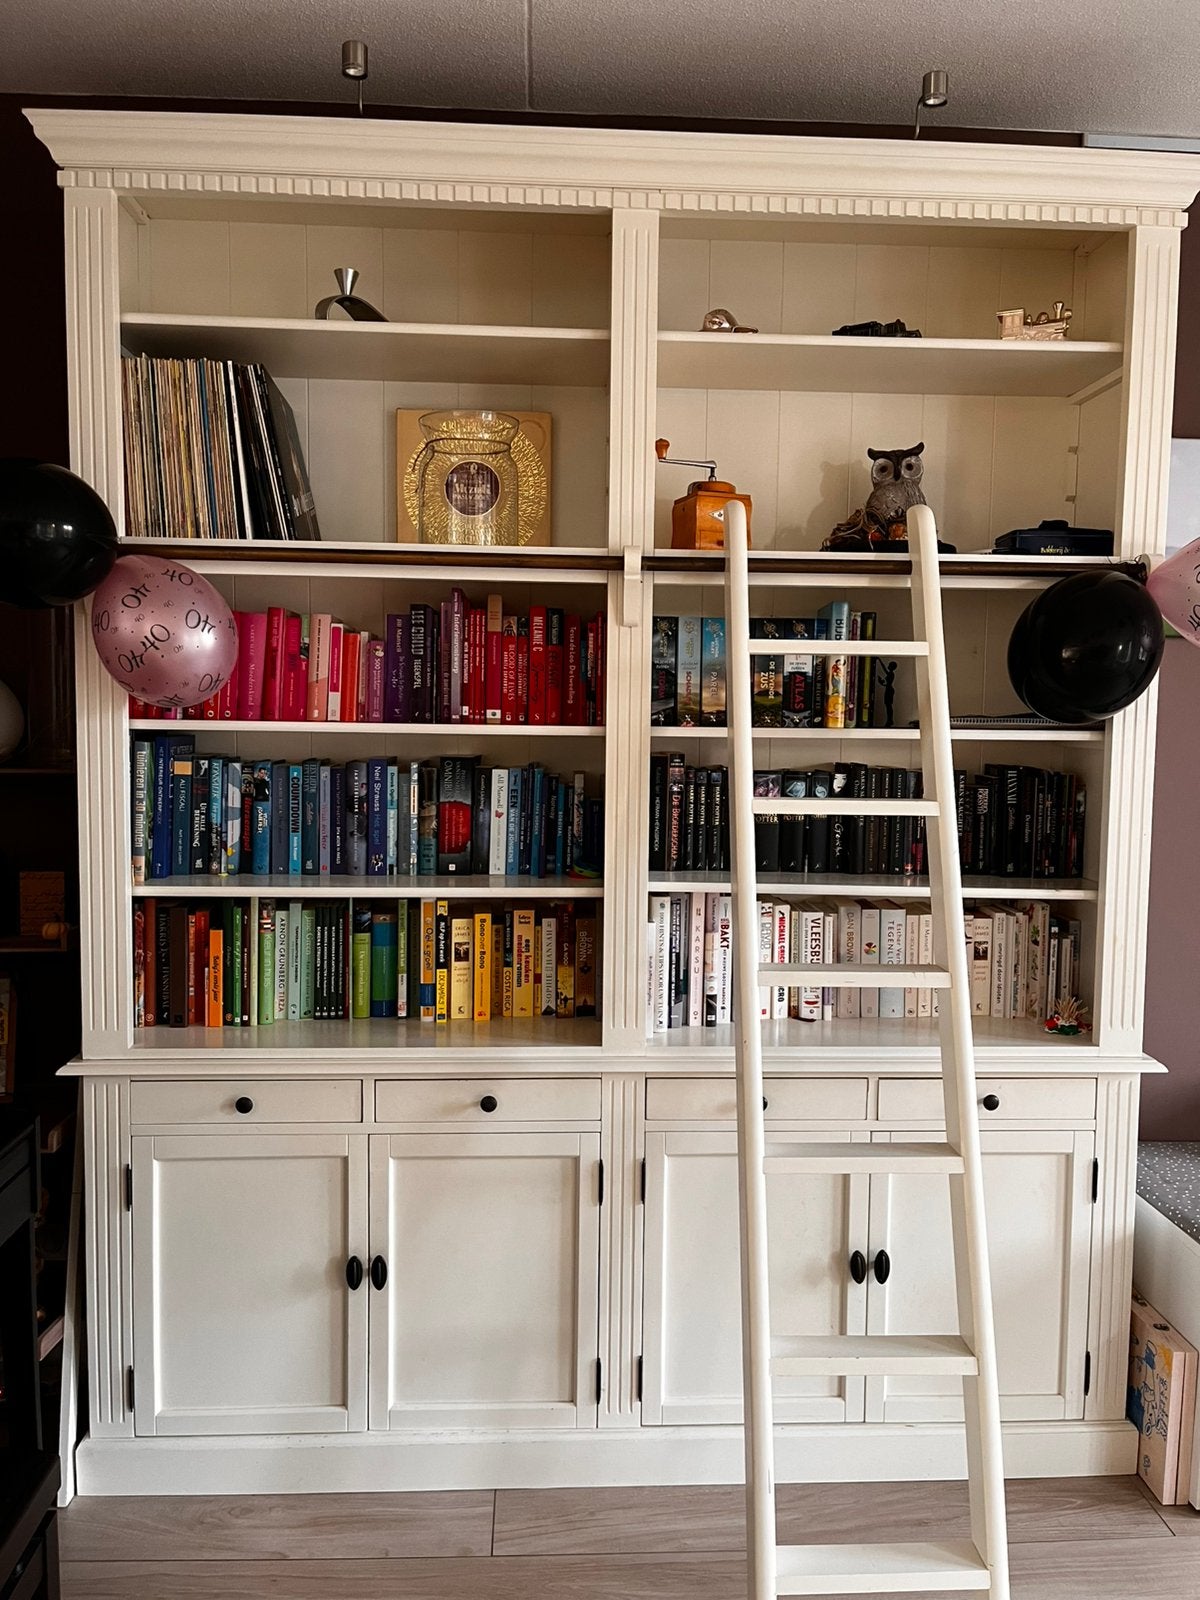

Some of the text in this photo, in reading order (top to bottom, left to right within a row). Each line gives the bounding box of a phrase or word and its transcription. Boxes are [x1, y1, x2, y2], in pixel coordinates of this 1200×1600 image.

[161, 568, 193, 586] 40
[122, 584, 151, 608] 40
[94, 610, 110, 632] 40
[186, 609, 216, 634] 40
[533, 616, 543, 645] MELANIE
[140, 624, 170, 652] 40
[411, 610, 424, 689] LEE CHILD TEGENSPEL
[452, 613, 460, 674] Interieurontwerp
[118, 650, 146, 673] 40
[569, 666, 575, 674] De
[769, 661, 775, 670] DE
[198, 674, 224, 692] 40
[508, 671, 515, 680] OF
[658, 671, 666, 698] STORM
[795, 674, 804, 710] ATLAS
[136, 751, 146, 788] tuinieren
[444, 760, 453, 800] OMNIBUS
[510, 789, 518, 808] EEN
[1007, 770, 1018, 804] HANNAH
[136, 800, 145, 811] 30
[291, 777, 300, 833] COUNTDOWN
[135, 814, 145, 847] minuten
[671, 794, 680, 859] DE BROEDERSCHAP
[264, 934, 272, 957] Kleur
[563, 942, 568, 951] GA
[720, 924, 730, 949] BAKT
[810, 918, 821, 963] VLEESBIJ
[360, 951, 365, 959] De
[263, 968, 272, 987] huis
